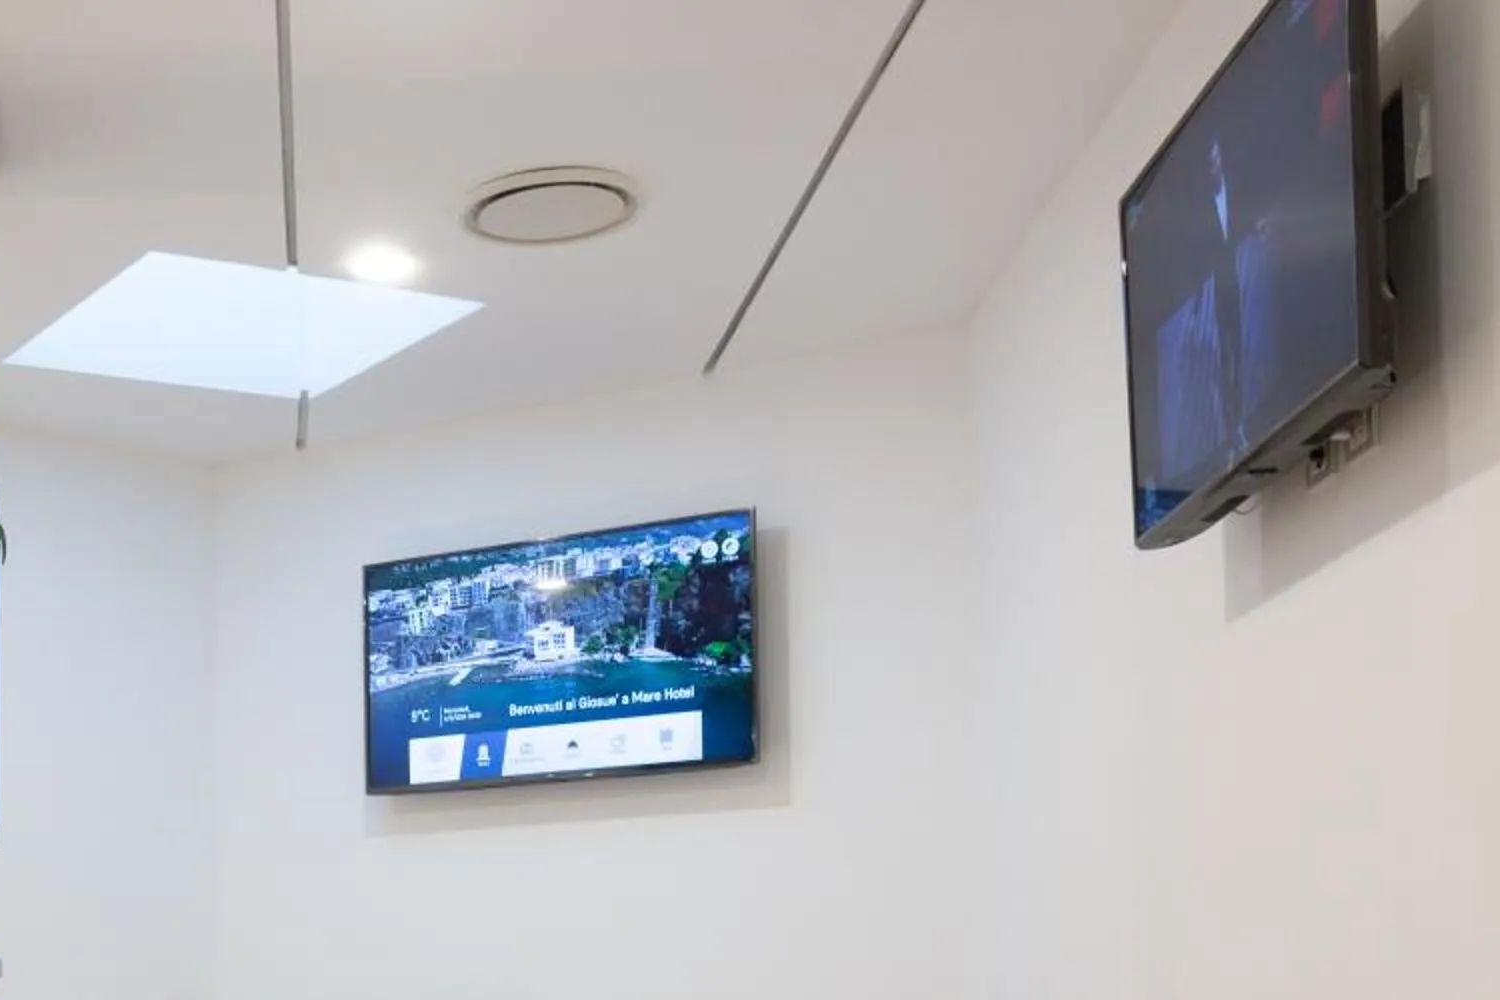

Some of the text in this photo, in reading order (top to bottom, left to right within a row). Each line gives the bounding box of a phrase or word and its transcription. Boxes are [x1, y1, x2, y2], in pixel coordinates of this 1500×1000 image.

[509, 699, 562, 716] Benvenuti
[621, 695, 629, 704] a
[631, 690, 661, 703] Mare
[664, 685, 695, 700] Hotel
